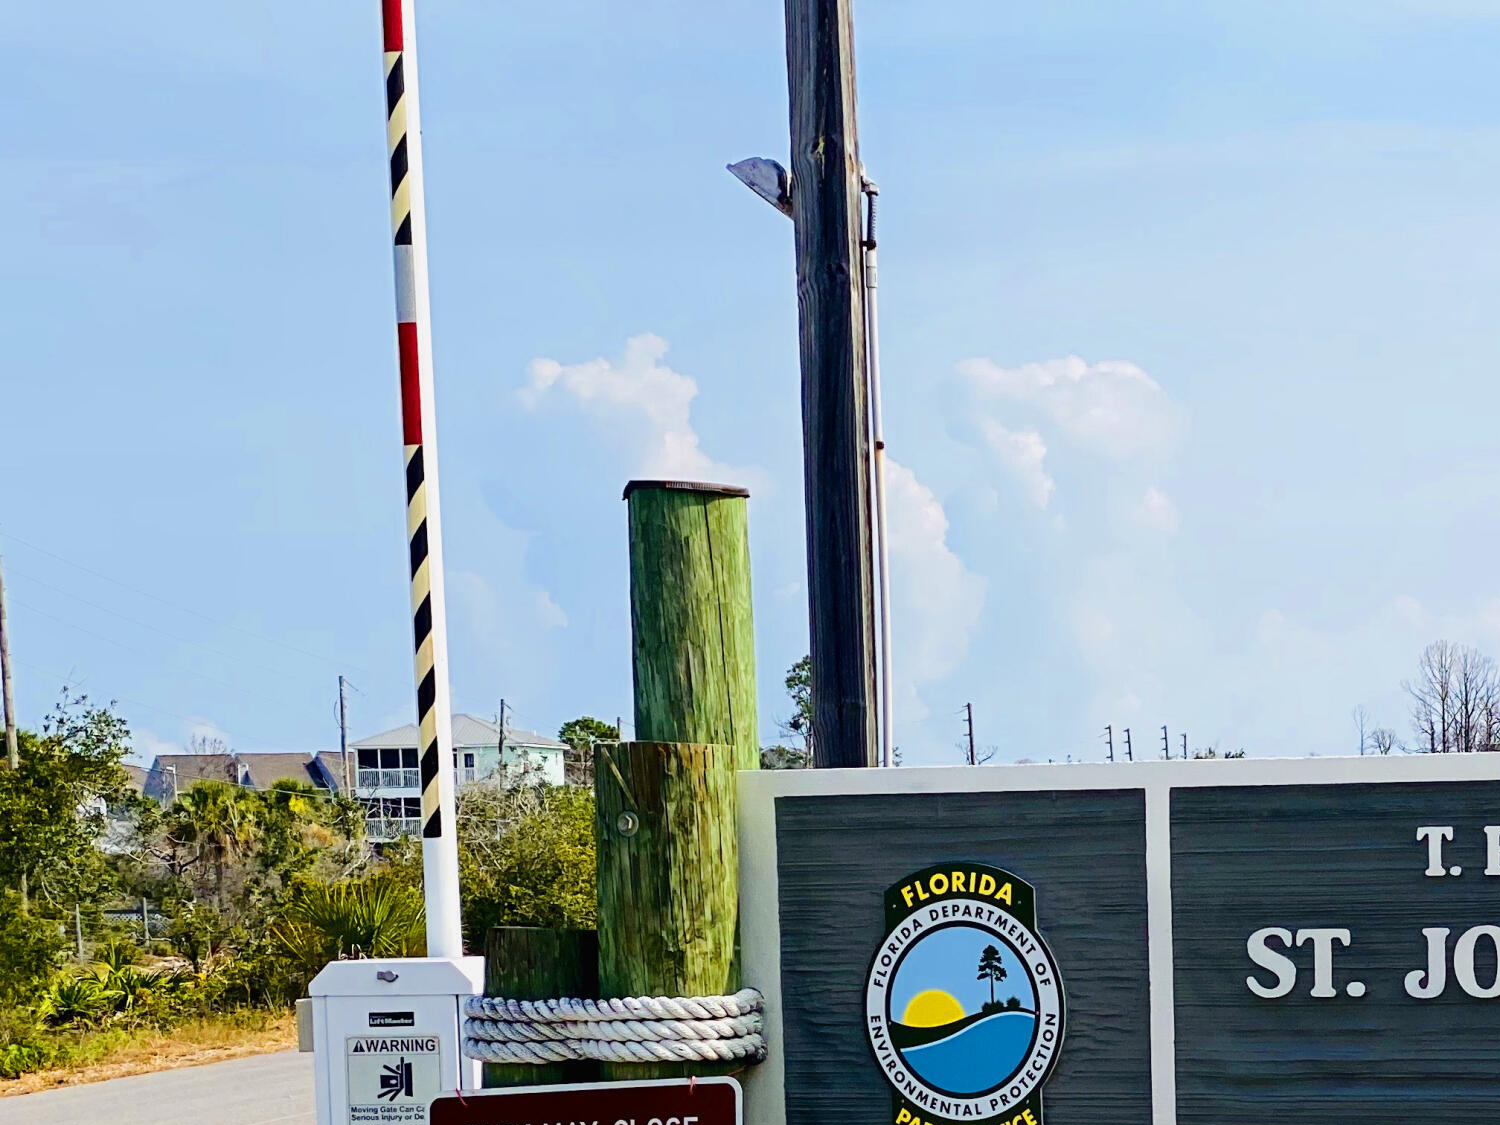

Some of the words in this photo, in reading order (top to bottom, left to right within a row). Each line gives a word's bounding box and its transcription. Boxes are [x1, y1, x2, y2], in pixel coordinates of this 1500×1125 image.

[1416, 826, 1462, 877] T.
[900, 871, 1013, 907] FLORIDA
[873, 918, 923, 988] FLORIDA
[929, 904, 1036, 955] DEPARTMENT
[1035, 962, 1051, 987] OF
[1246, 927, 1366, 999] ST.
[365, 1039, 436, 1053] WARNING
[870, 1015, 982, 1117] ENVIRONMENTAL
[991, 1013, 1056, 1112] PROTECTION
[351, 1106, 379, 1115] Moving
[399, 1105, 414, 1113] Can
[381, 1113, 403, 1122] Injury
